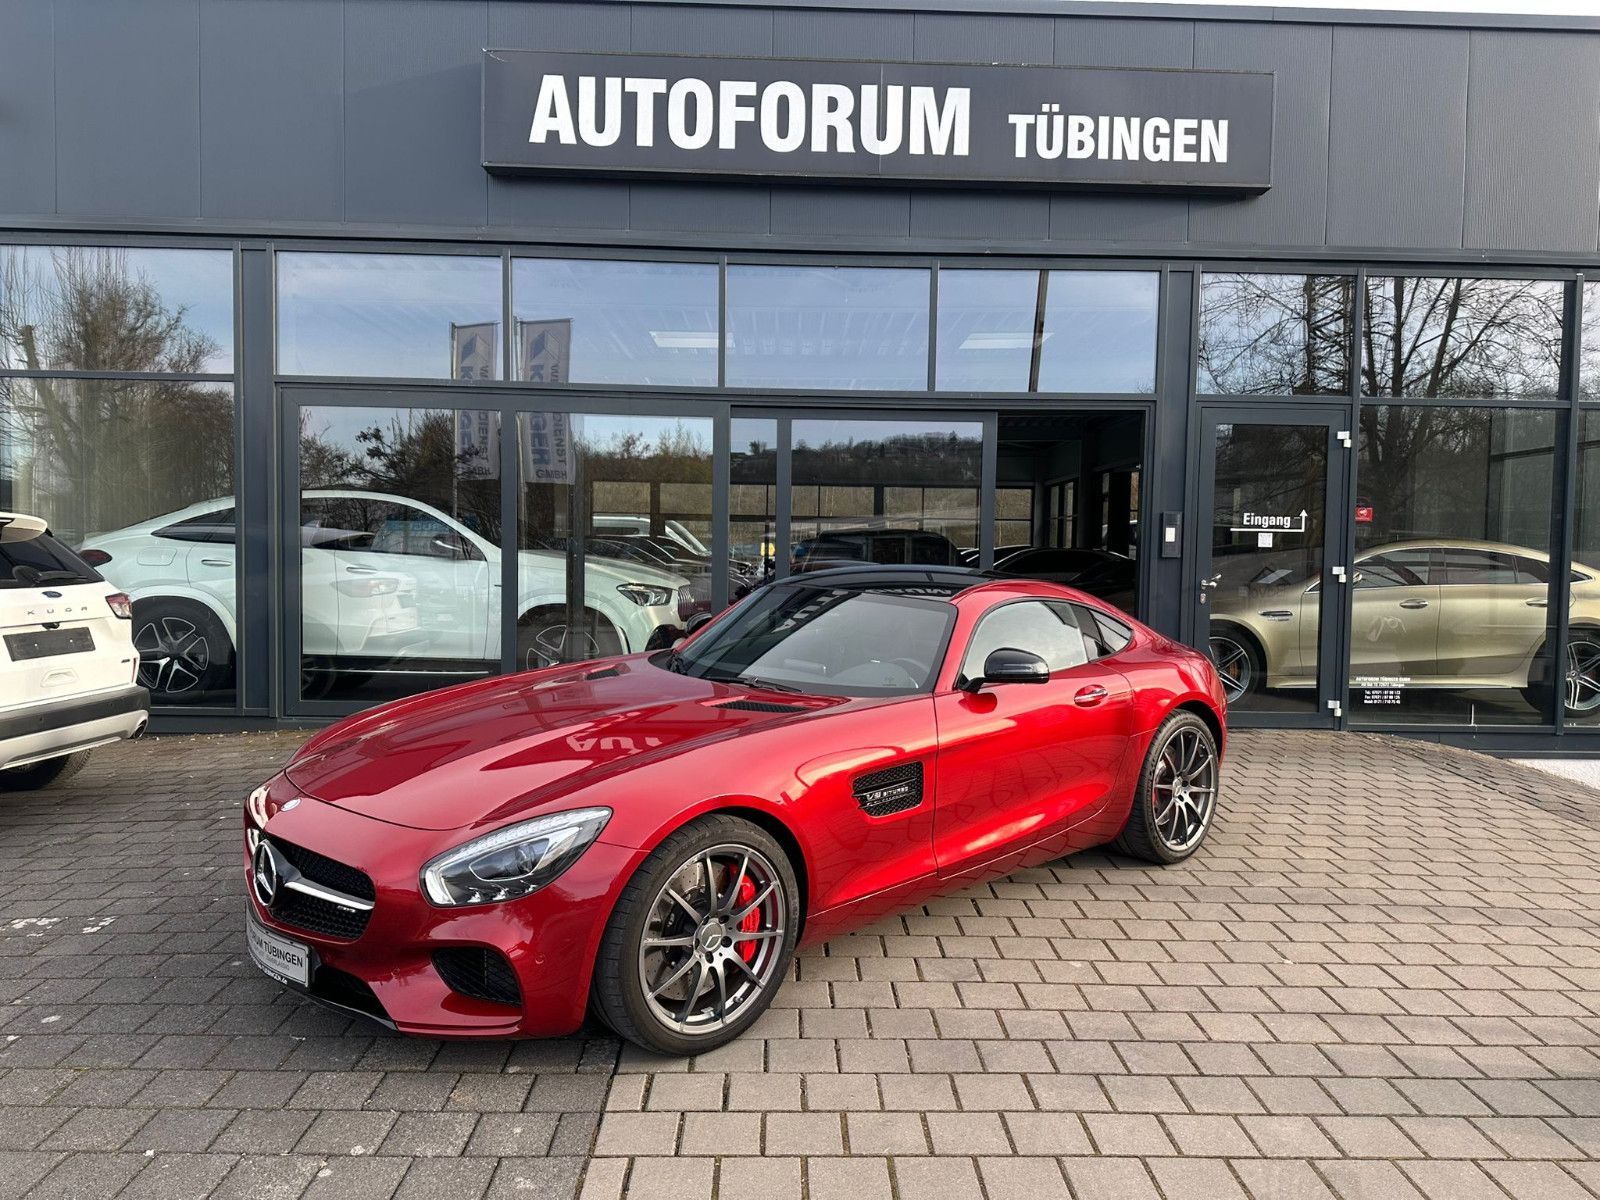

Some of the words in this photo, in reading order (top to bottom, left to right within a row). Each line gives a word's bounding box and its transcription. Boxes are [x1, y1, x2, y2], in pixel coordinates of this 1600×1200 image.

[528, 74, 971, 157] AUTOFORUM
[1007, 103, 1230, 164] TÜBINGEN
[1243, 512, 1291, 528] Eingang
[27, 606, 88, 616] KUGA
[264, 941, 303, 968] TÜBINGEN
